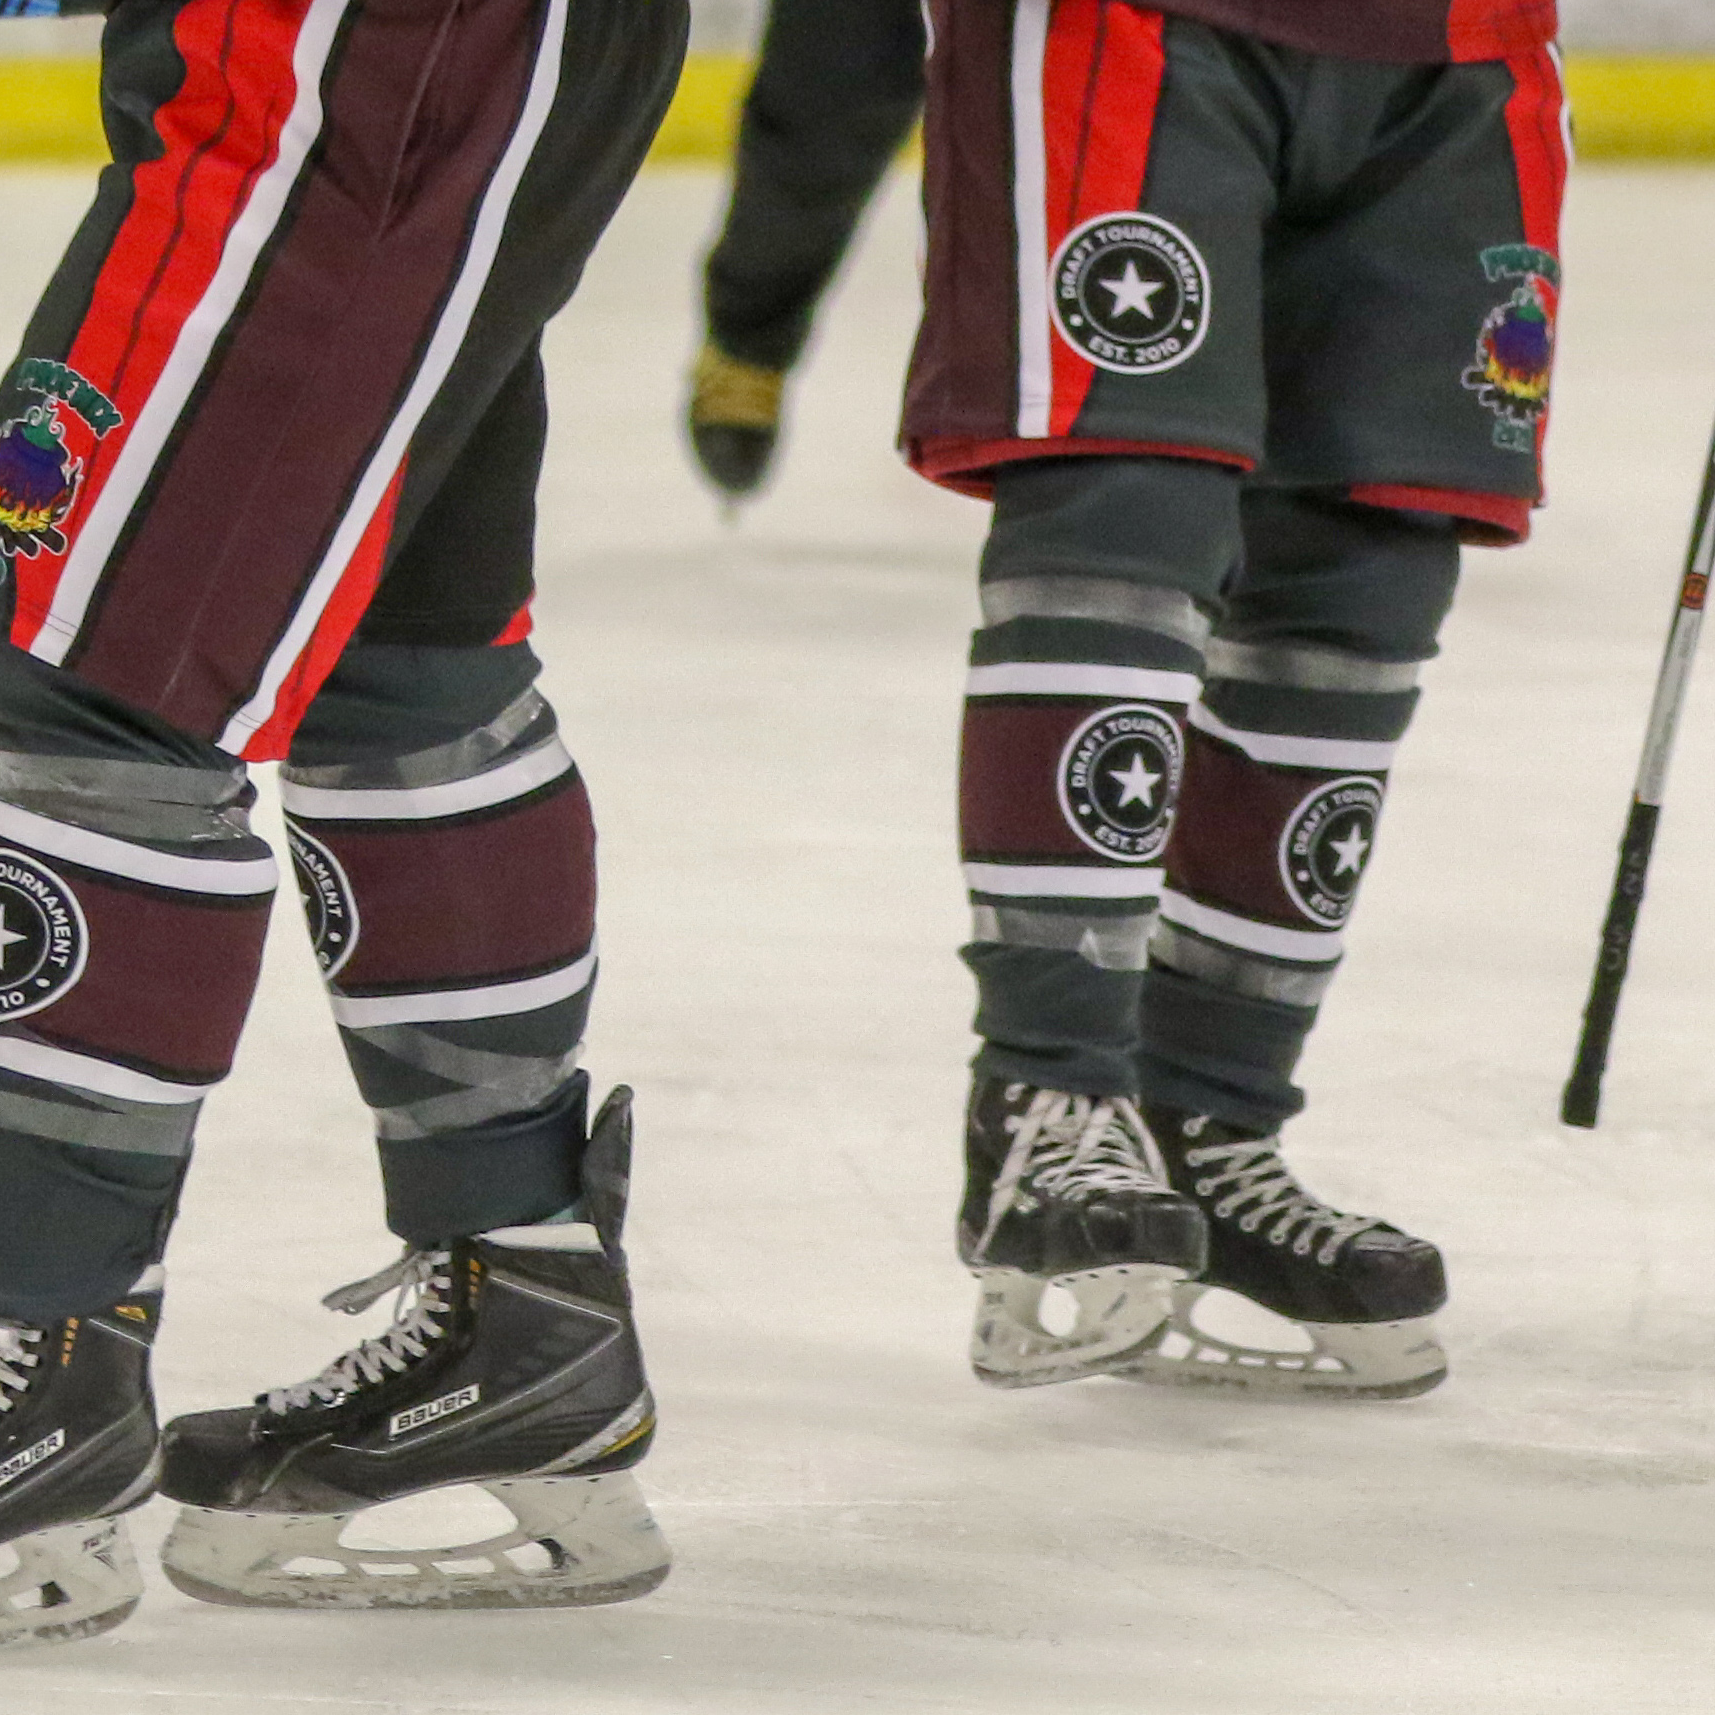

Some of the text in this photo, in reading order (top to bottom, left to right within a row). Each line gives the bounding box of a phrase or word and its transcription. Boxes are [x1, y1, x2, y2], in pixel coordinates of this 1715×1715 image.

[1094, 225, 1200, 304] TOURNAMENT
[1134, 337, 1181, 365] 2010
[398, 1390, 472, 1429] BAUER
